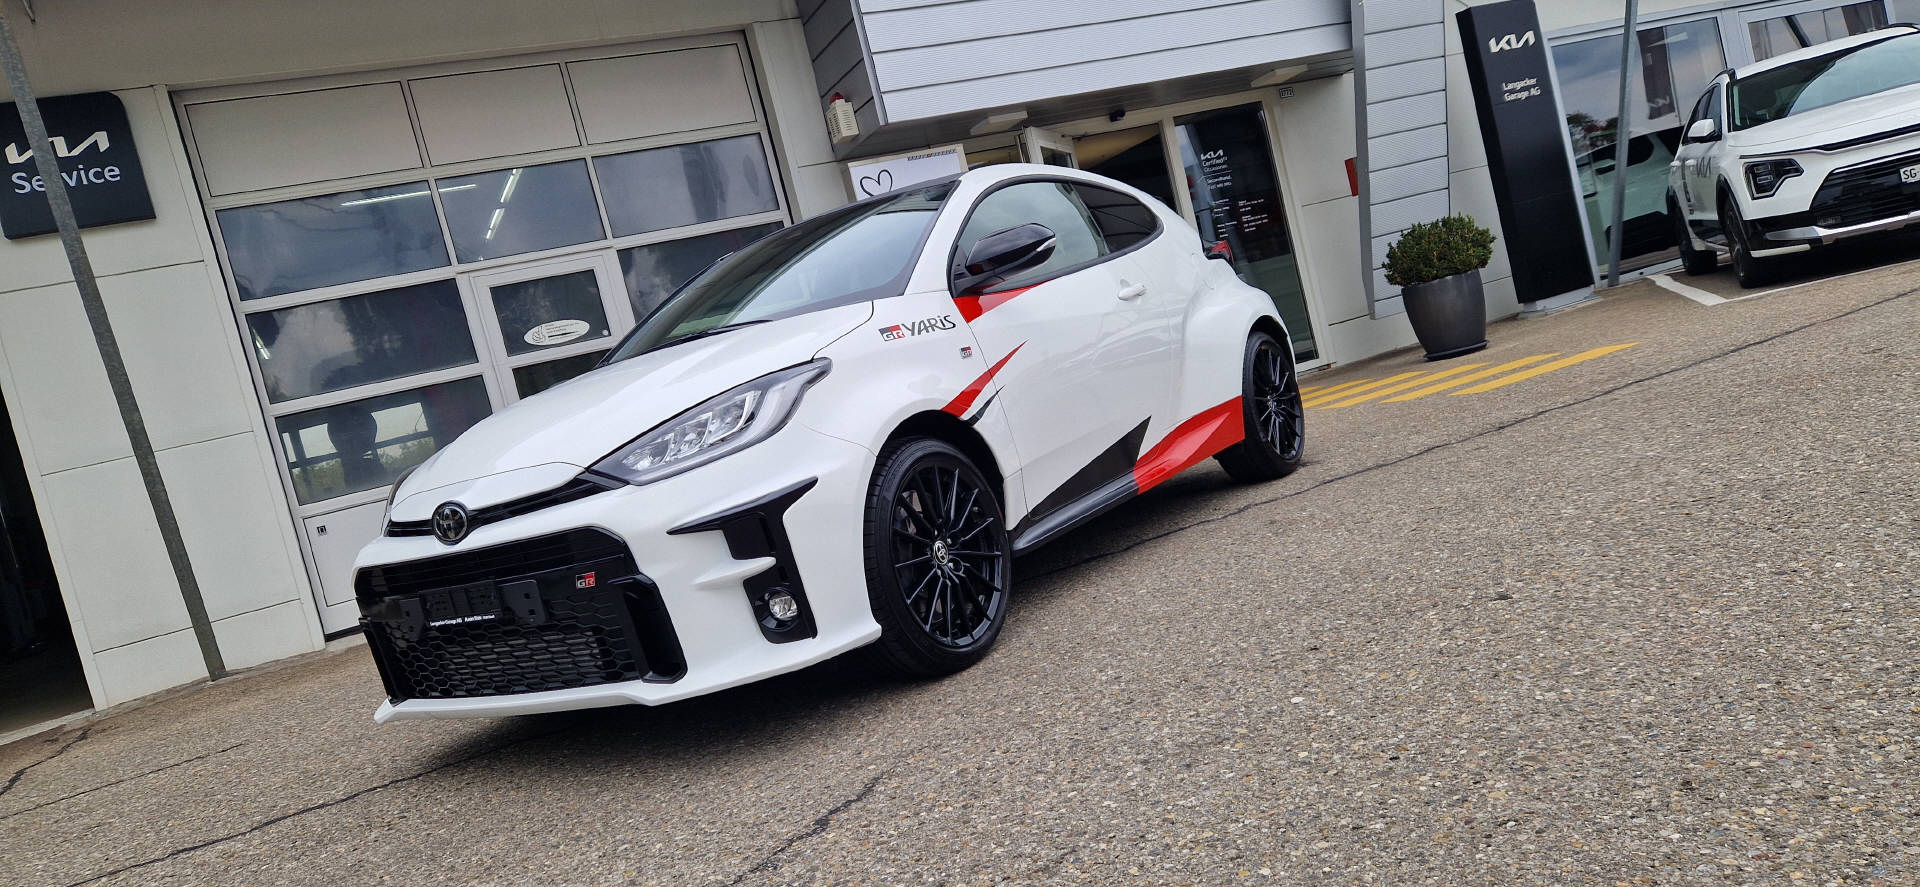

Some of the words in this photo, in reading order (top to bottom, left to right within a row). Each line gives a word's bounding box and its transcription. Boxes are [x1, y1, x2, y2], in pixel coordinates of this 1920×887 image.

[1488, 30, 1536, 53] KIA
[1502, 77, 1537, 92] Langacker
[1504, 90, 1530, 102] Garage
[1529, 86, 1541, 96] AG
[1200, 149, 1224, 160] KIA
[11, 164, 121, 194] Sevice
[880, 328, 905, 341] GR
